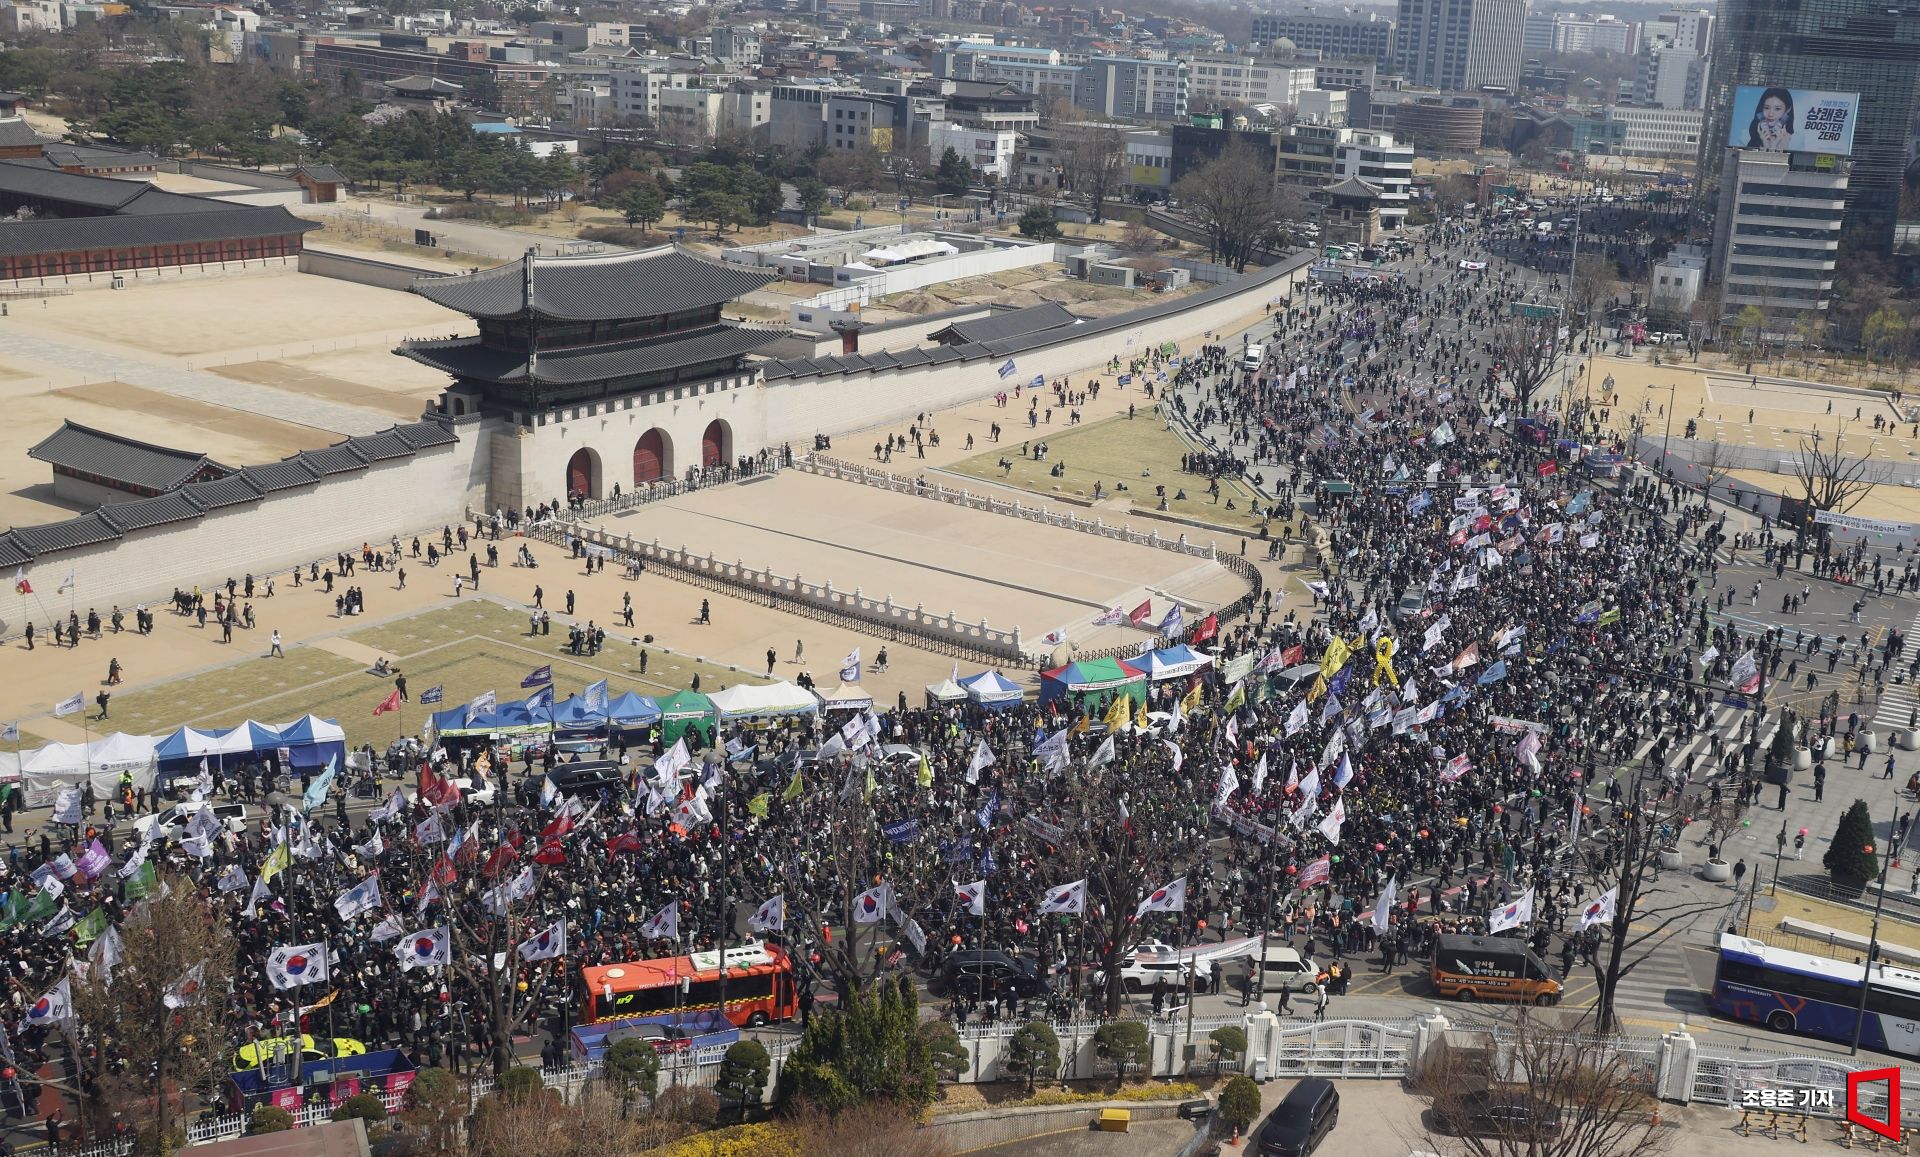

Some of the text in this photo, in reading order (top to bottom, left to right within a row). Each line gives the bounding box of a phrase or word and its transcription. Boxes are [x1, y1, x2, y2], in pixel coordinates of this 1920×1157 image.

[1806, 107, 1848, 122] 상쾌환
[1804, 122, 1844, 132] BOOSTER
[1818, 132, 1841, 142] ZERO
[1747, 989, 1772, 997] UNIVERSITY
[616, 994, 634, 1005] 119
